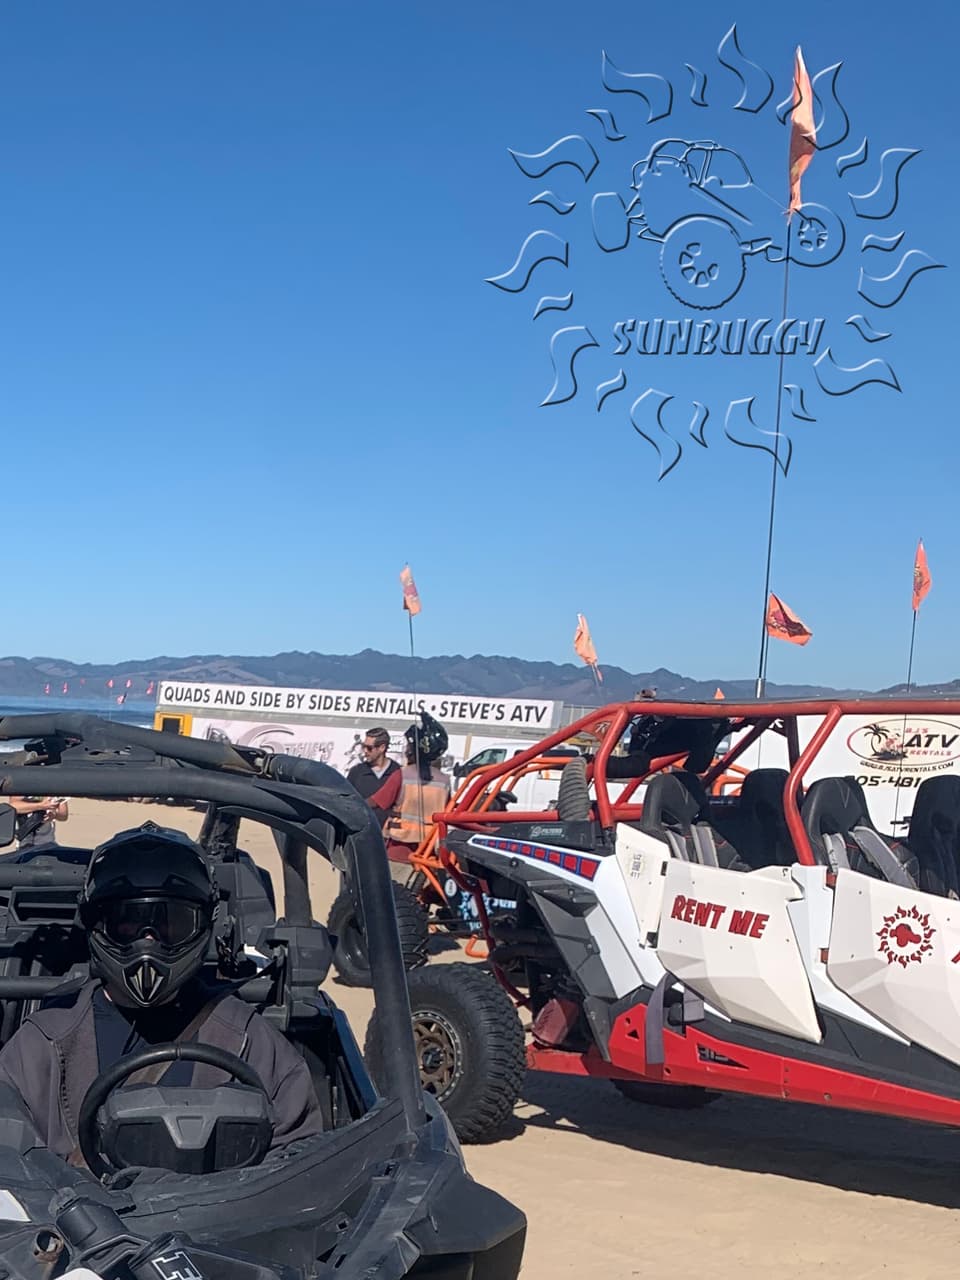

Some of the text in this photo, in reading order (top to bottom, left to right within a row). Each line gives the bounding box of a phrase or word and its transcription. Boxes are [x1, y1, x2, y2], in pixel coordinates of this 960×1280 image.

[164, 686, 547, 723] QUADS AND SIDE BY SIDES RENTALS STEVE'S ATV
[904, 734, 960, 748] ATV
[670, 894, 770, 939] RENT ME
